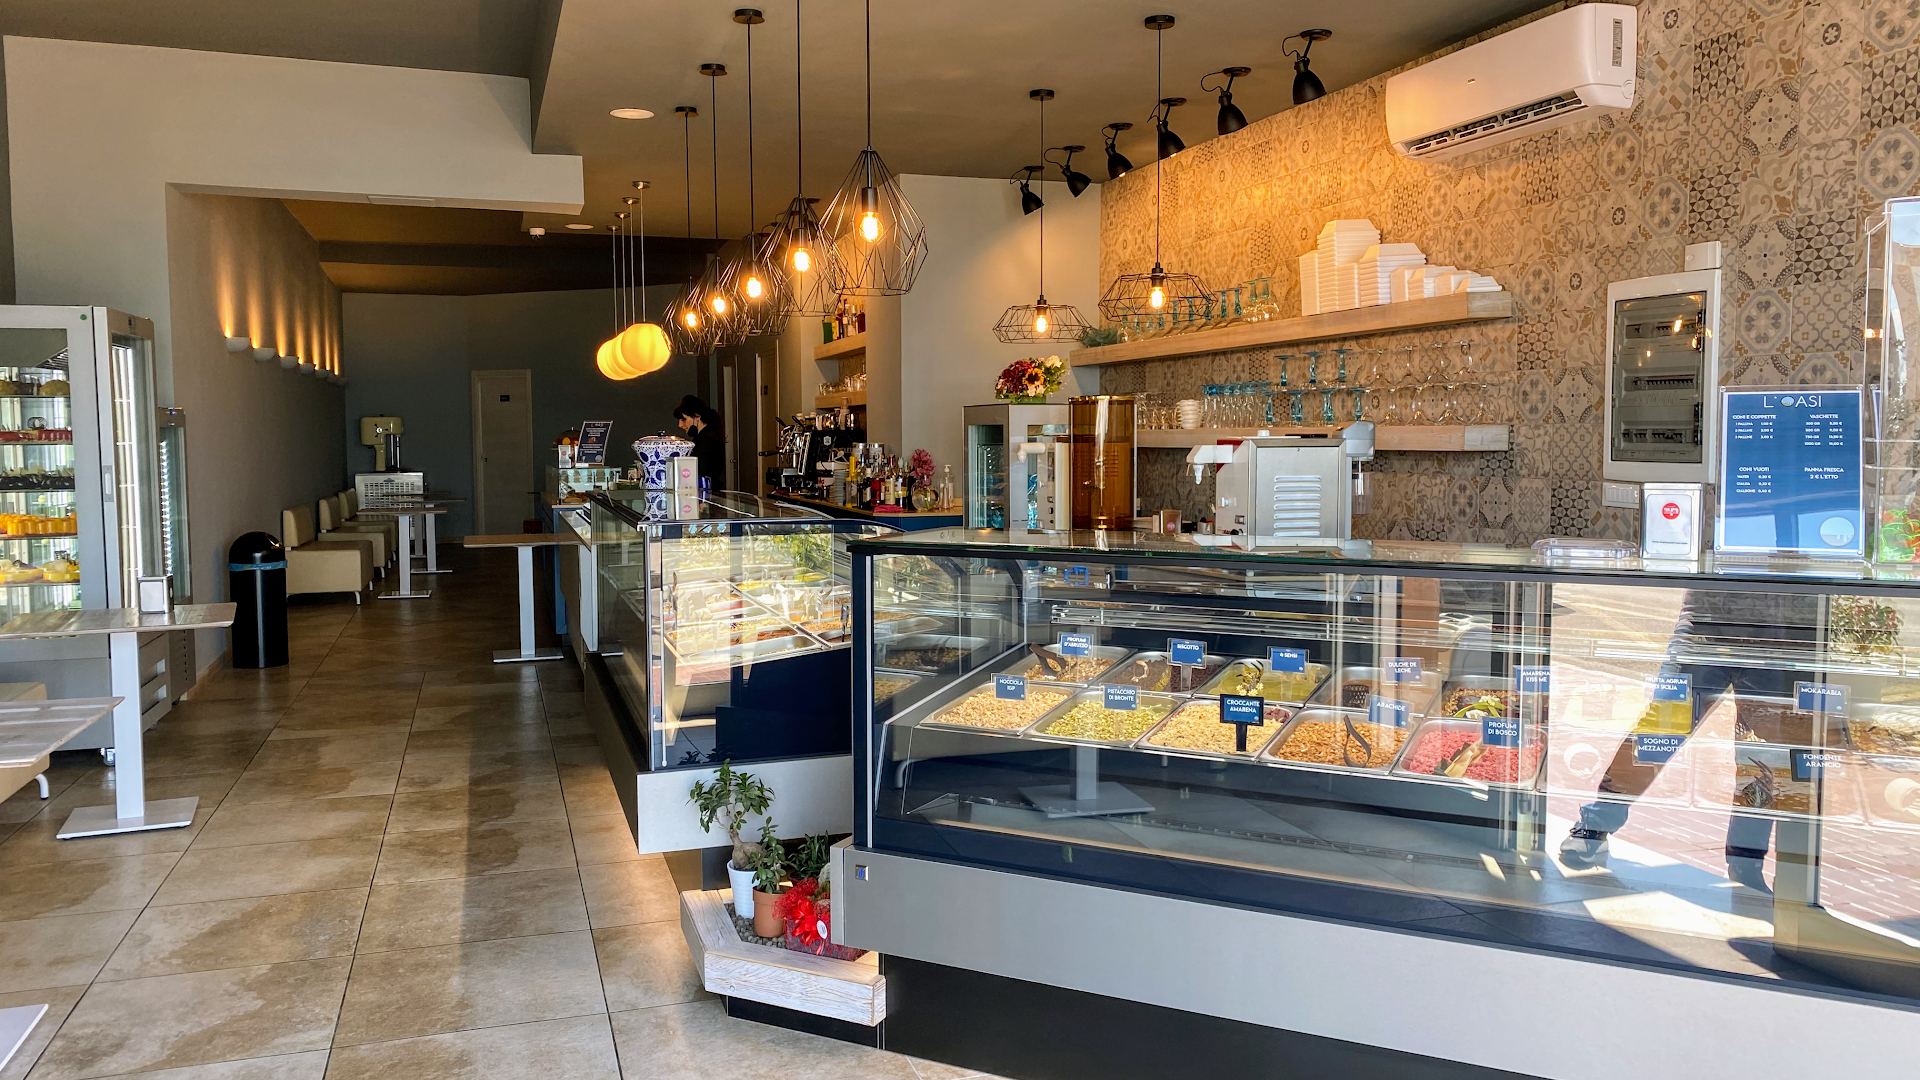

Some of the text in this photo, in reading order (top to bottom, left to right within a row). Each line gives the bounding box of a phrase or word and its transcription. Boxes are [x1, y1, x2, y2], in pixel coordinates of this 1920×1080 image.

[1176, 643, 1200, 651] BISCOTTO
[999, 678, 1024, 686] NOCCIOLA
[1665, 677, 1687, 685] AGRUMI
[1107, 688, 1136, 696] PISTACCHIO
[1800, 687, 1842, 696] MOKARABIA
[1114, 694, 1134, 702] BRONTE
[1226, 699, 1260, 707] CROCCANTE
[1376, 701, 1406, 712] ARACHIDE
[1229, 706, 1257, 714] AMARENA
[1488, 721, 1517, 729] PROFUMI
[1495, 729, 1518, 737] BOSCO
[1643, 737, 1670, 745] SOGNO
[1803, 753, 1843, 761] FONDENTE
[1805, 761, 1842, 769] ARANCIO
